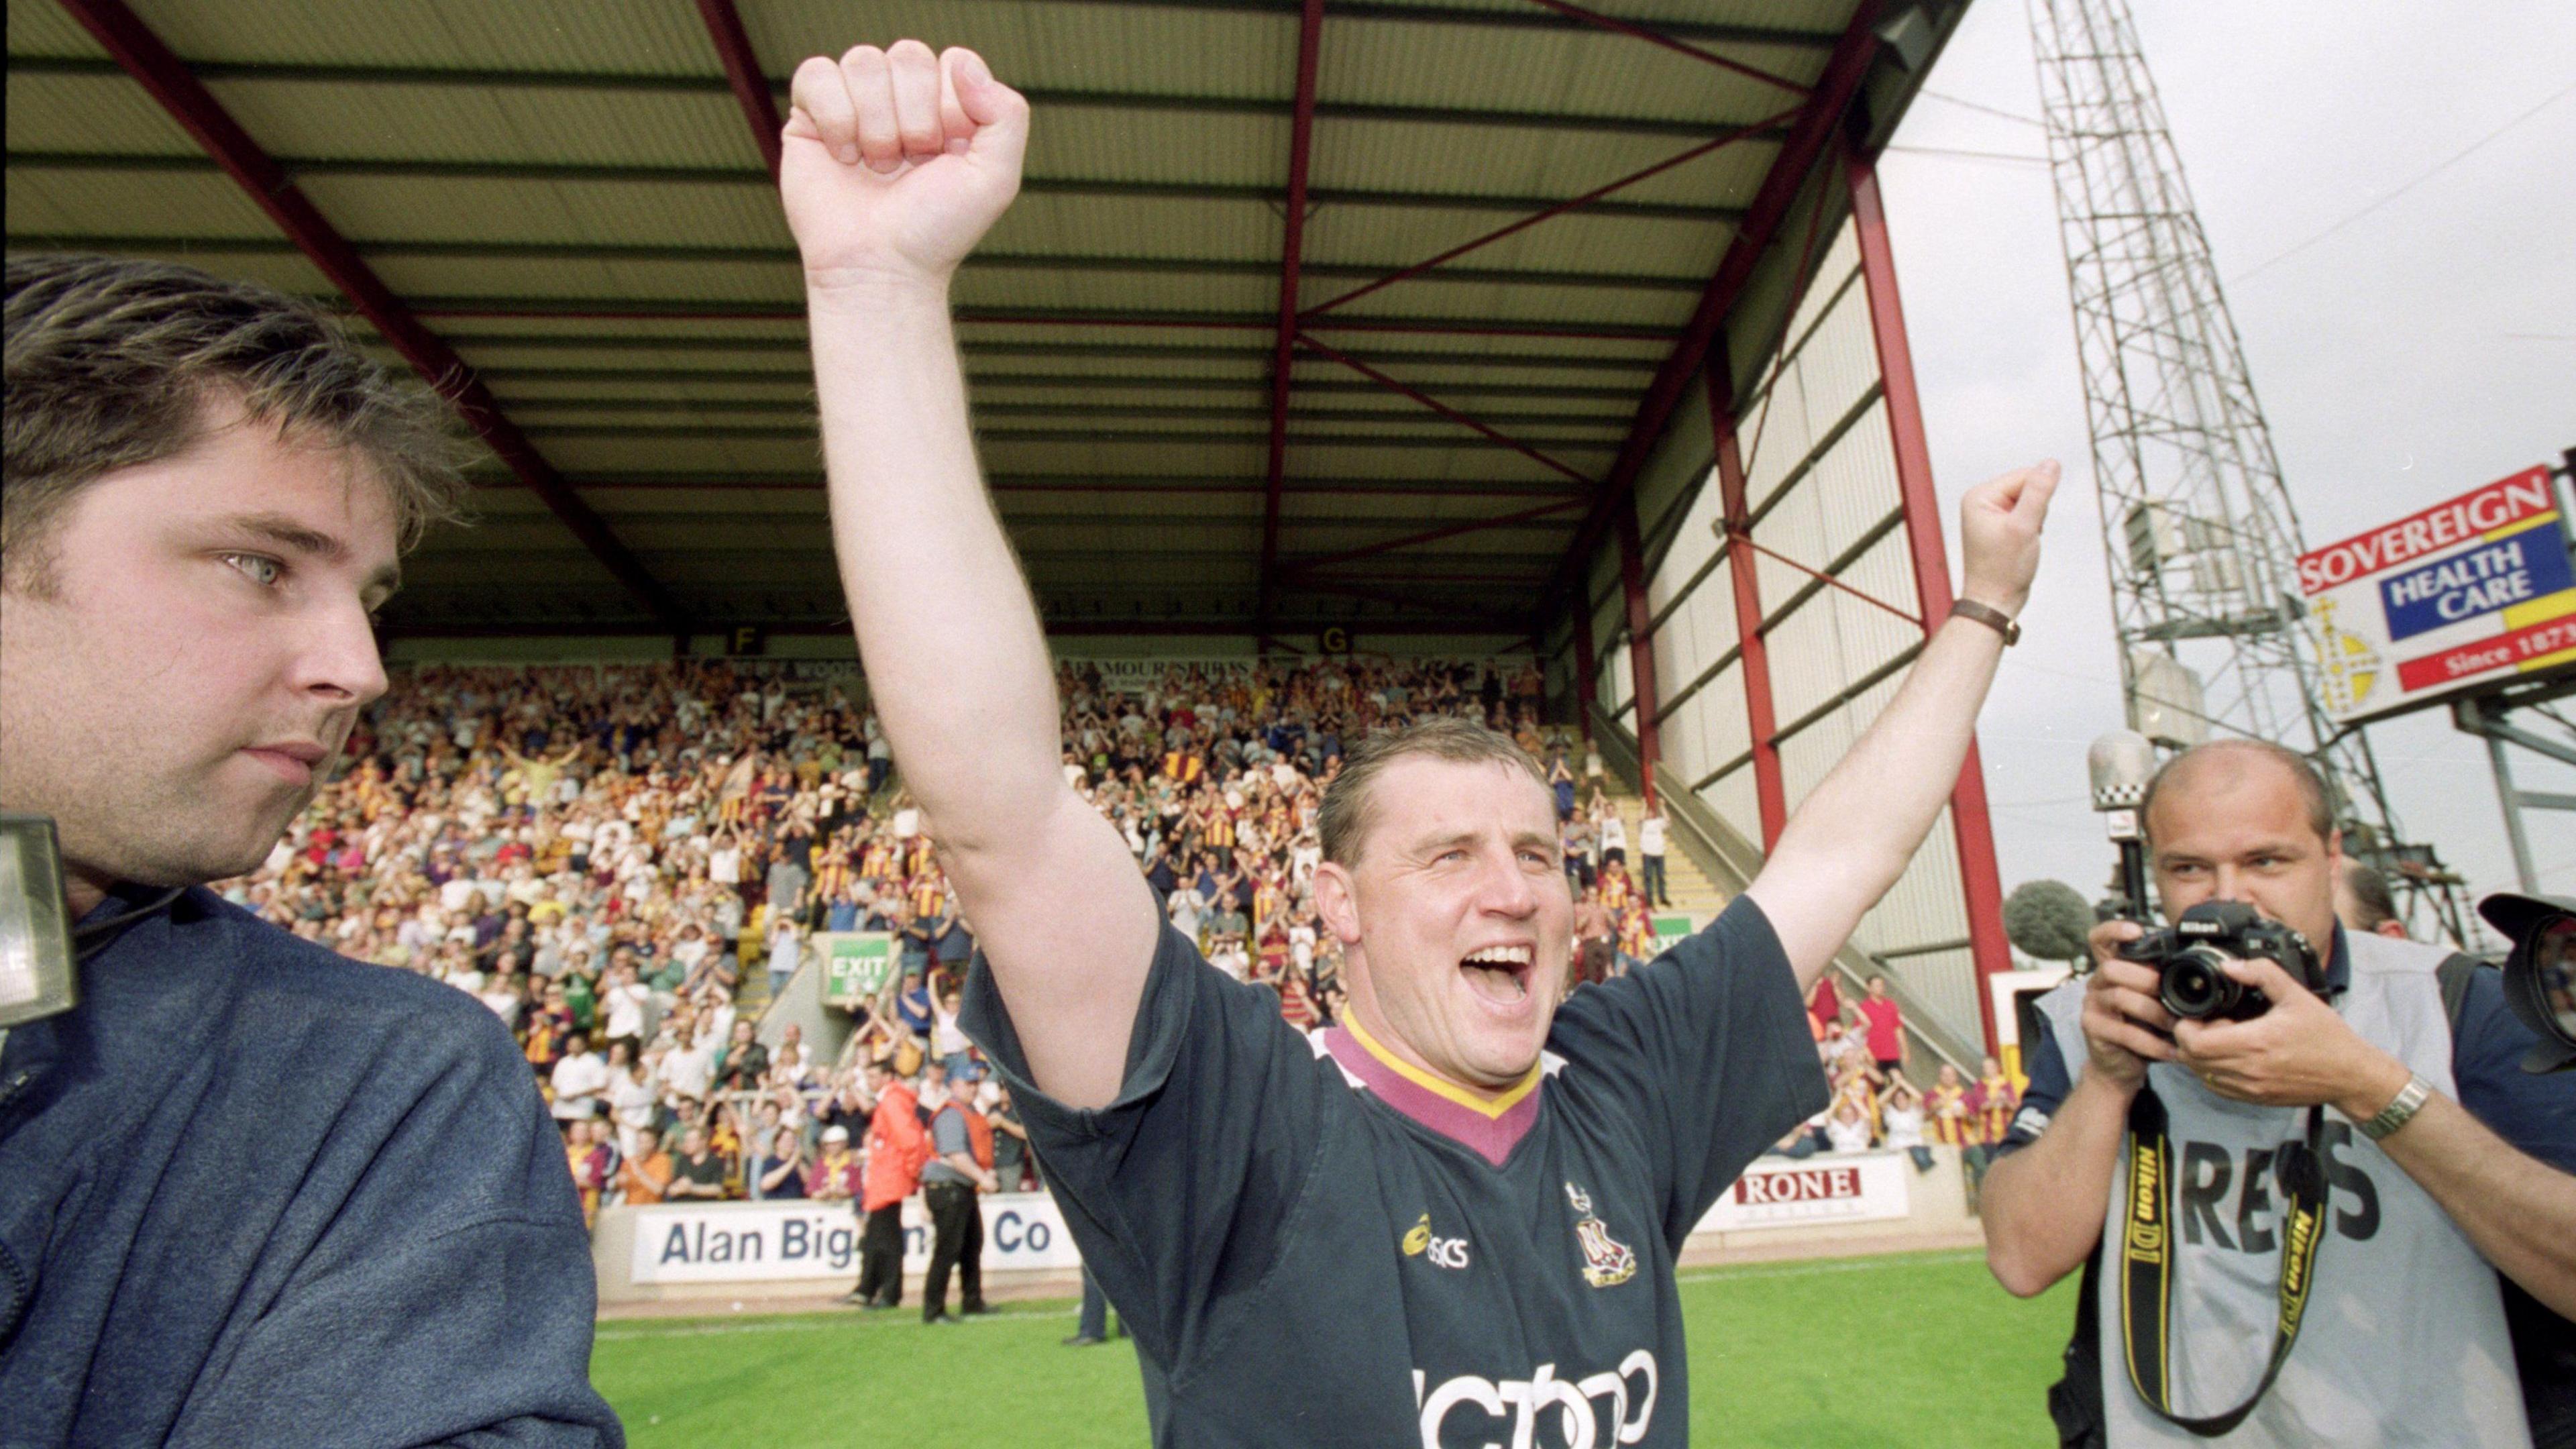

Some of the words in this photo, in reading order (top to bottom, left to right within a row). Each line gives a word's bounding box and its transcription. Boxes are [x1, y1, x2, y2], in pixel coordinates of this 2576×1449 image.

[2300, 474, 2550, 592] SOVEREIGN
[2390, 541, 2525, 607] HEALTH
[2436, 569, 2534, 620] CARE
[737, 627, 756, 652] F
[1323, 627, 1347, 653] G
[2445, 647, 2511, 676] Since
[2516, 623, 2576, 656] 1873
[831, 955, 885, 977] EXIT
[1745, 1168, 1854, 1204] RONE
[2137, 1145, 2157, 1222] Nikon
[661, 1222, 763, 1265] Alan
[994, 1210, 1051, 1252] Co
[2286, 1209, 2314, 1292] Nikon
